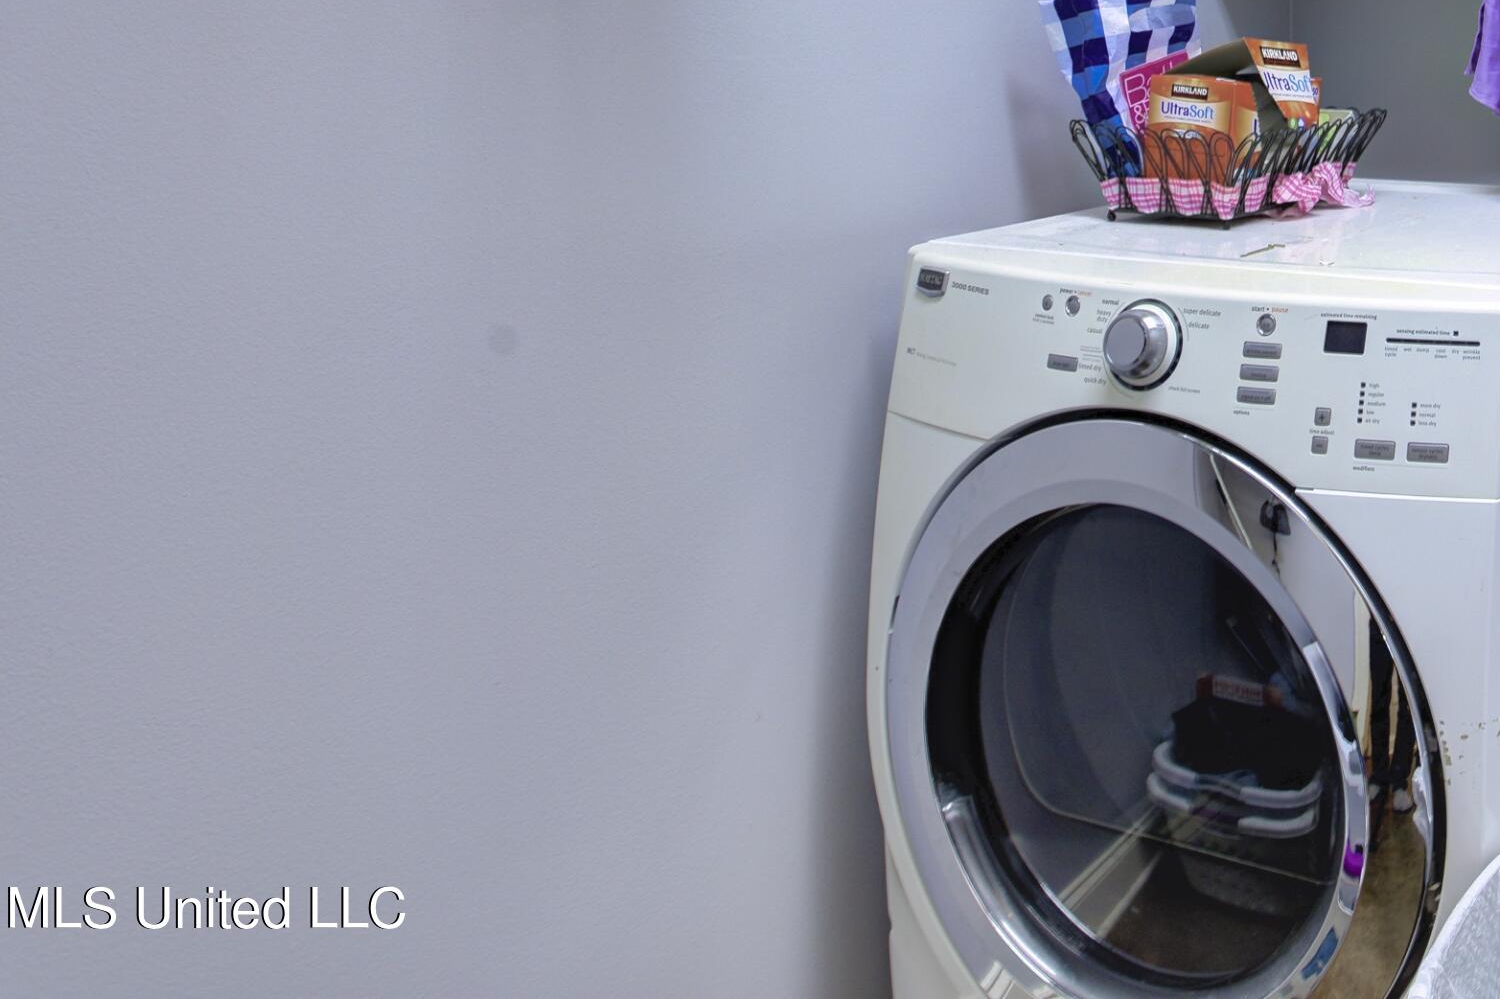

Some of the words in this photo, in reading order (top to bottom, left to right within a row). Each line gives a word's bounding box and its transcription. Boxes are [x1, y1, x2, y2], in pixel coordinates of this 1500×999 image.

[1261, 48, 1298, 61] KIRKLAND
[1173, 85, 1208, 96] KIRKLAND
[1161, 101, 1214, 120] UltraSoft
[952, 281, 967, 292] 3000
[967, 284, 989, 295] SERIES
[1101, 299, 1120, 307] normal
[1097, 309, 1111, 318] heavy
[1183, 307, 1198, 316] super
[1198, 307, 1221, 317] delicate
[1097, 315, 1109, 324] duty
[1188, 320, 1210, 330] delicate
[1093, 364, 1102, 373] dry
[1084, 376, 1097, 385] quick
[1098, 377, 1107, 386] dry
